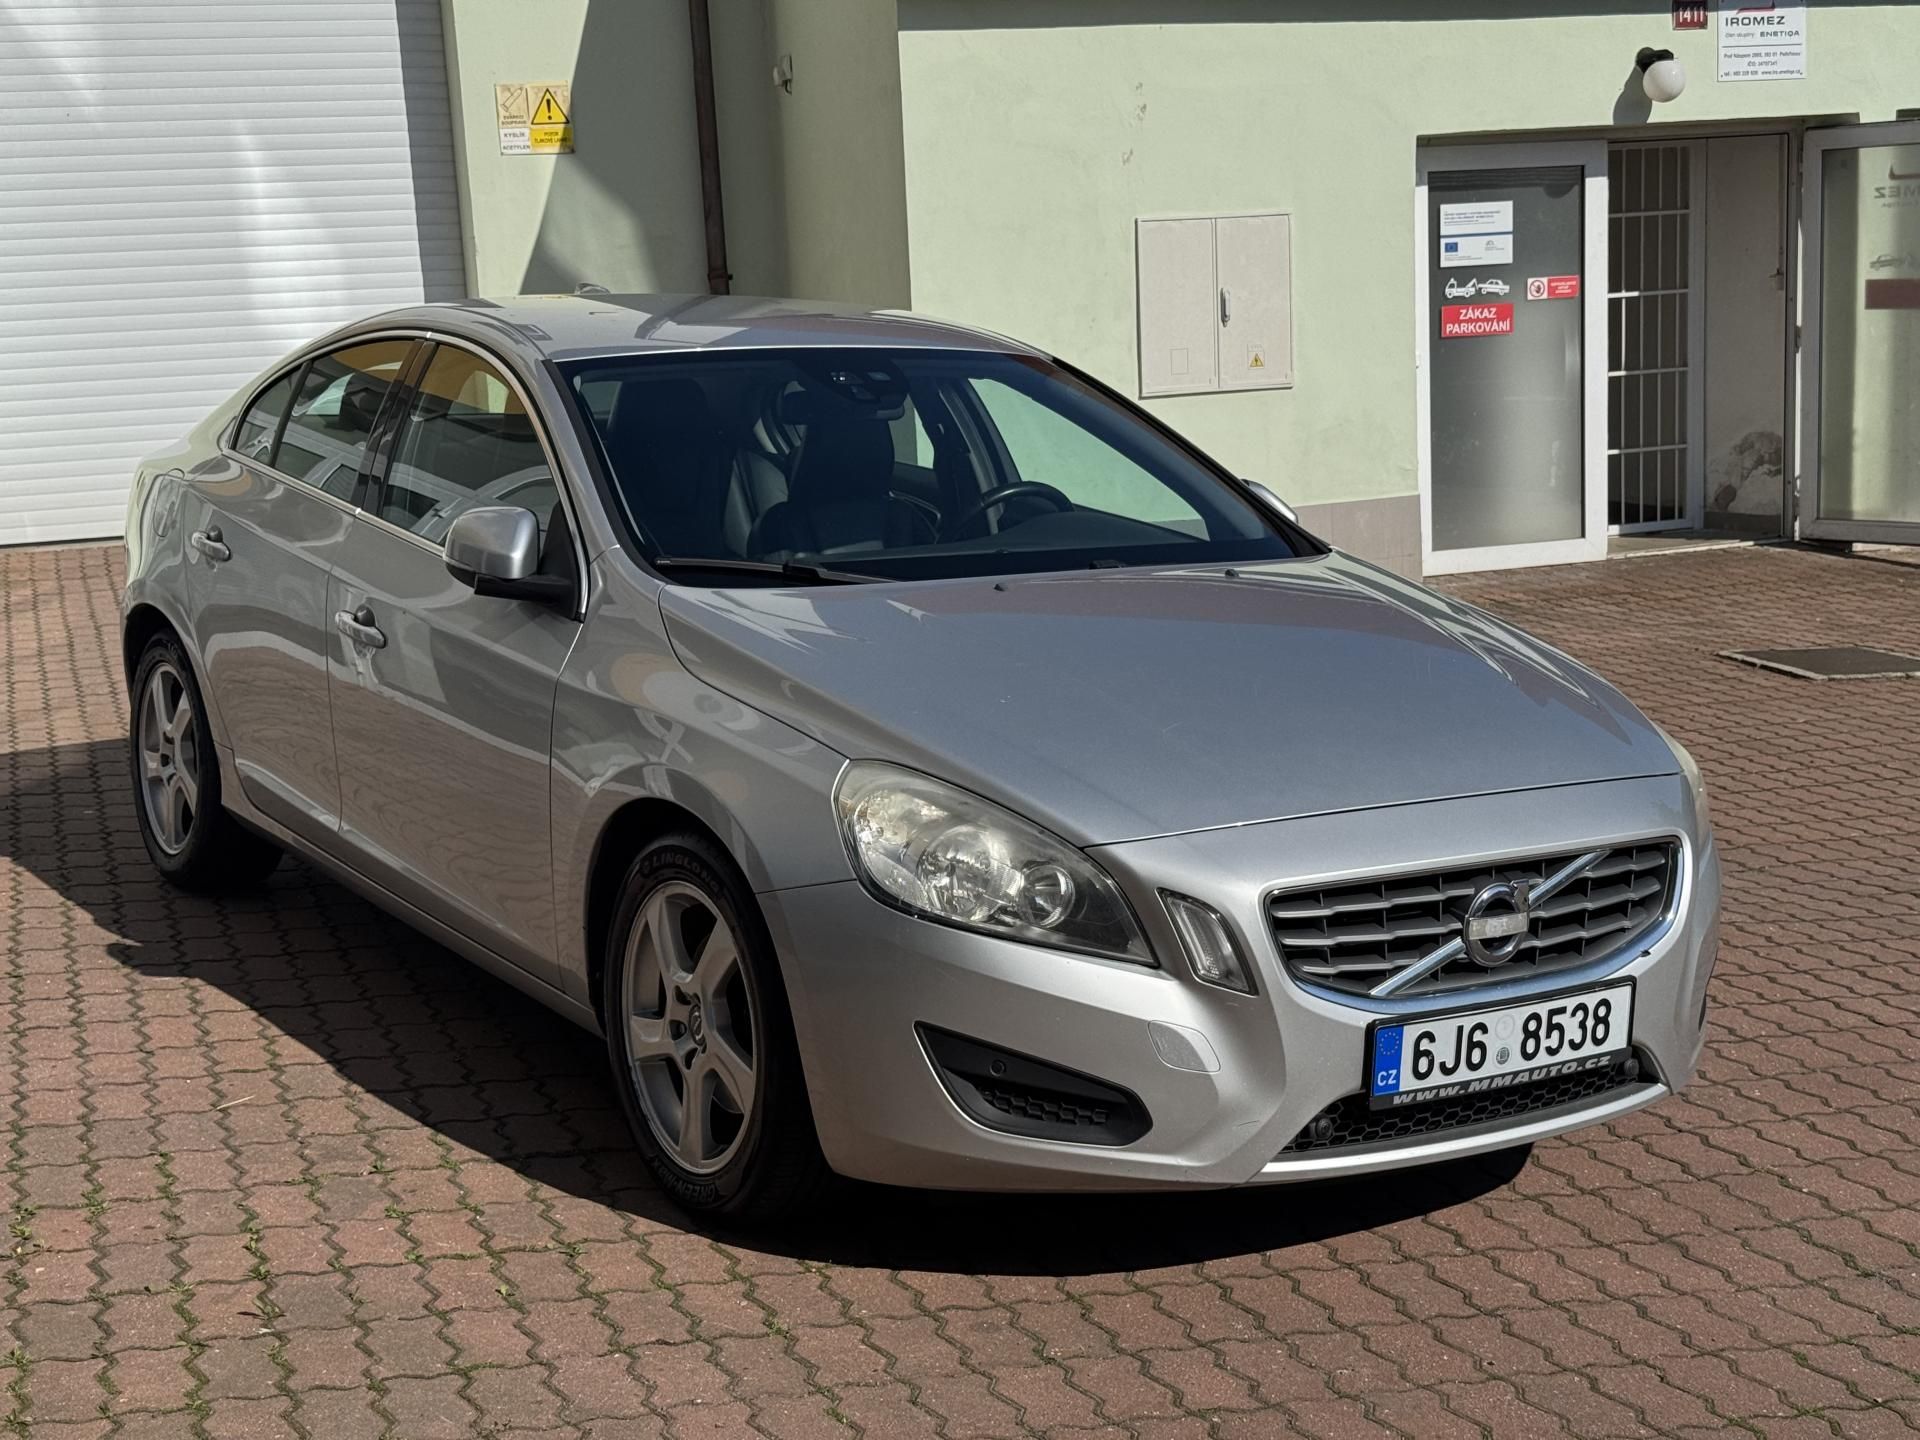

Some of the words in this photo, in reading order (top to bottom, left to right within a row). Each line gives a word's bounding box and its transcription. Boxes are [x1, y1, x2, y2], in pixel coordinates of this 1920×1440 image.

[1679, 7, 1704, 23] 1411
[1725, 16, 1785, 27] IROMEZ
[1459, 306, 1497, 320] ZÁKAZ
[1446, 317, 1511, 334] PARKOVÁNÍ
[1411, 1022, 1489, 1081] 6J6
[1520, 998, 1612, 1062] 8538
[1377, 1069, 1397, 1087] CZ
